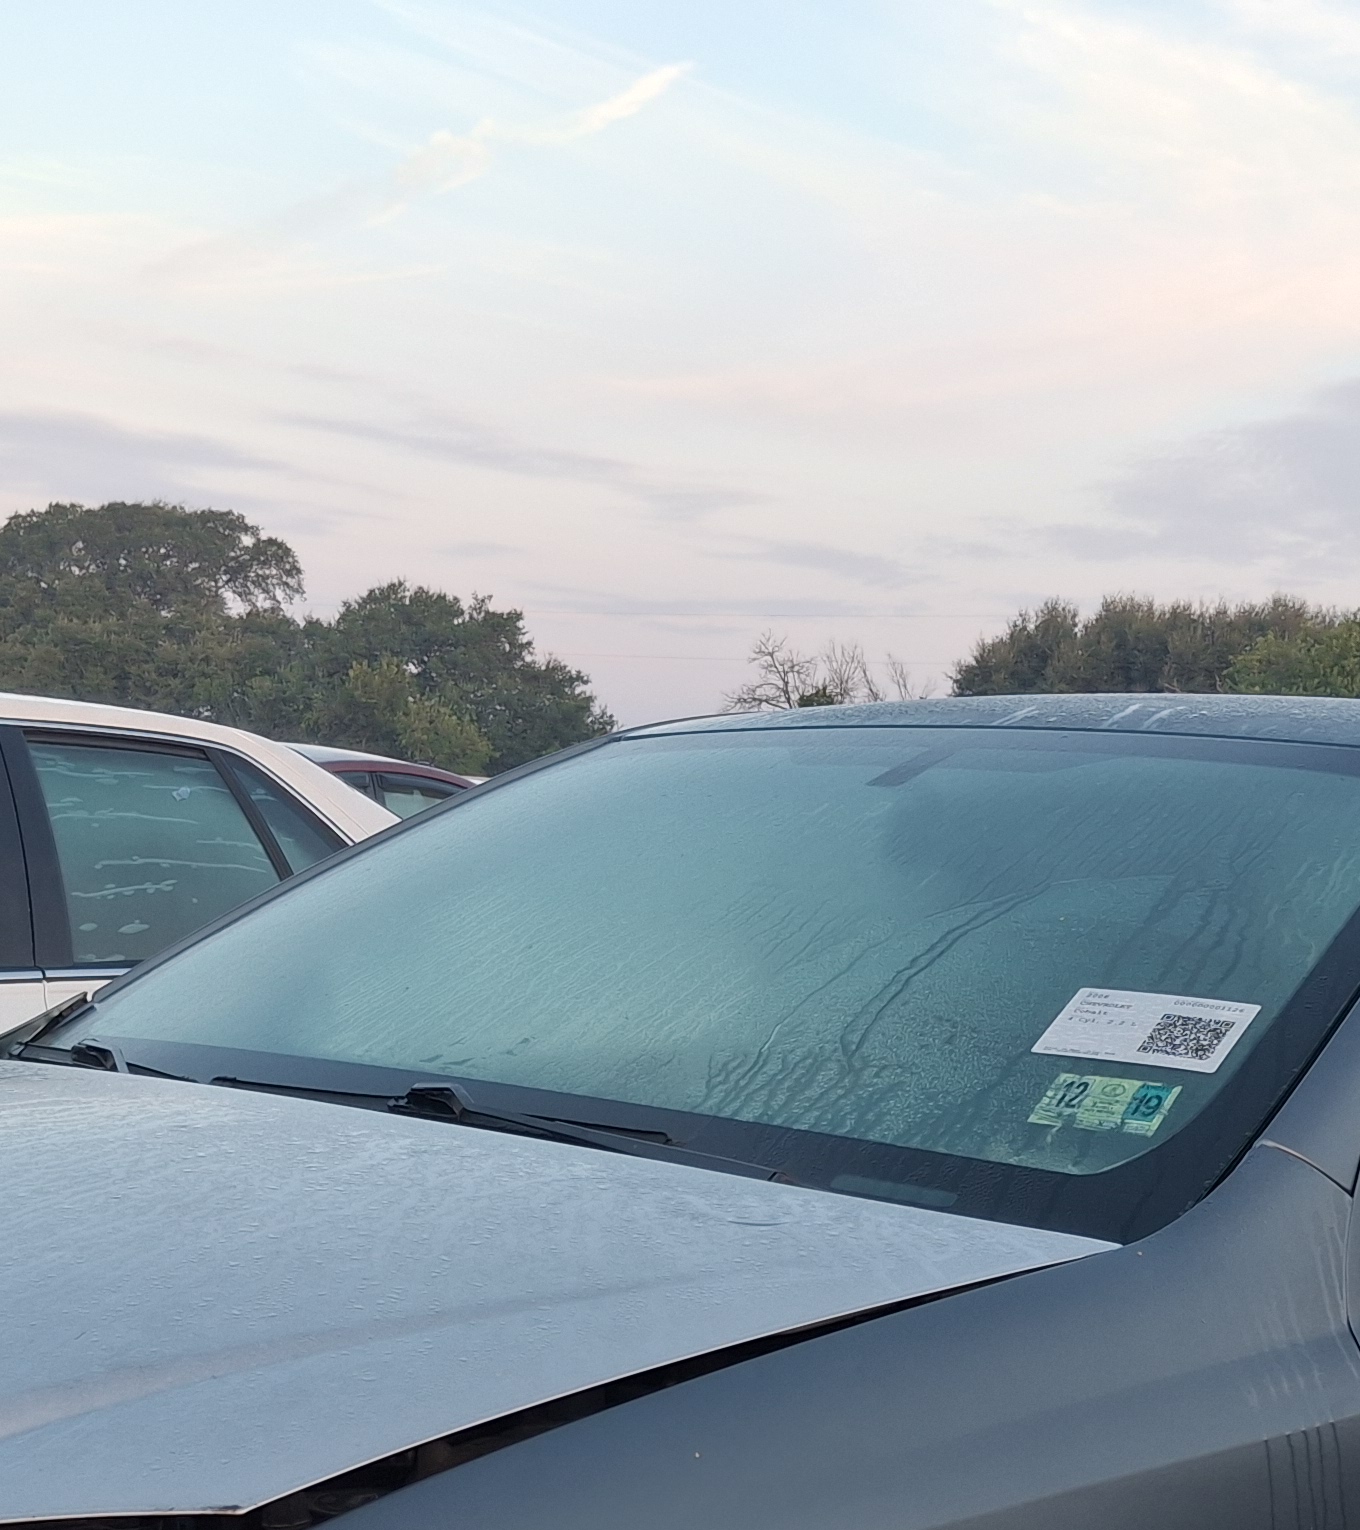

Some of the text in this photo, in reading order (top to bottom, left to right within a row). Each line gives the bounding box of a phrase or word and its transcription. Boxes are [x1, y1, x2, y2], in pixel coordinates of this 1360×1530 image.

[1080, 1001, 1133, 1009] CHEVROLET
[1056, 1080, 1090, 1109] 12
[1131, 1093, 1163, 1117] 19
